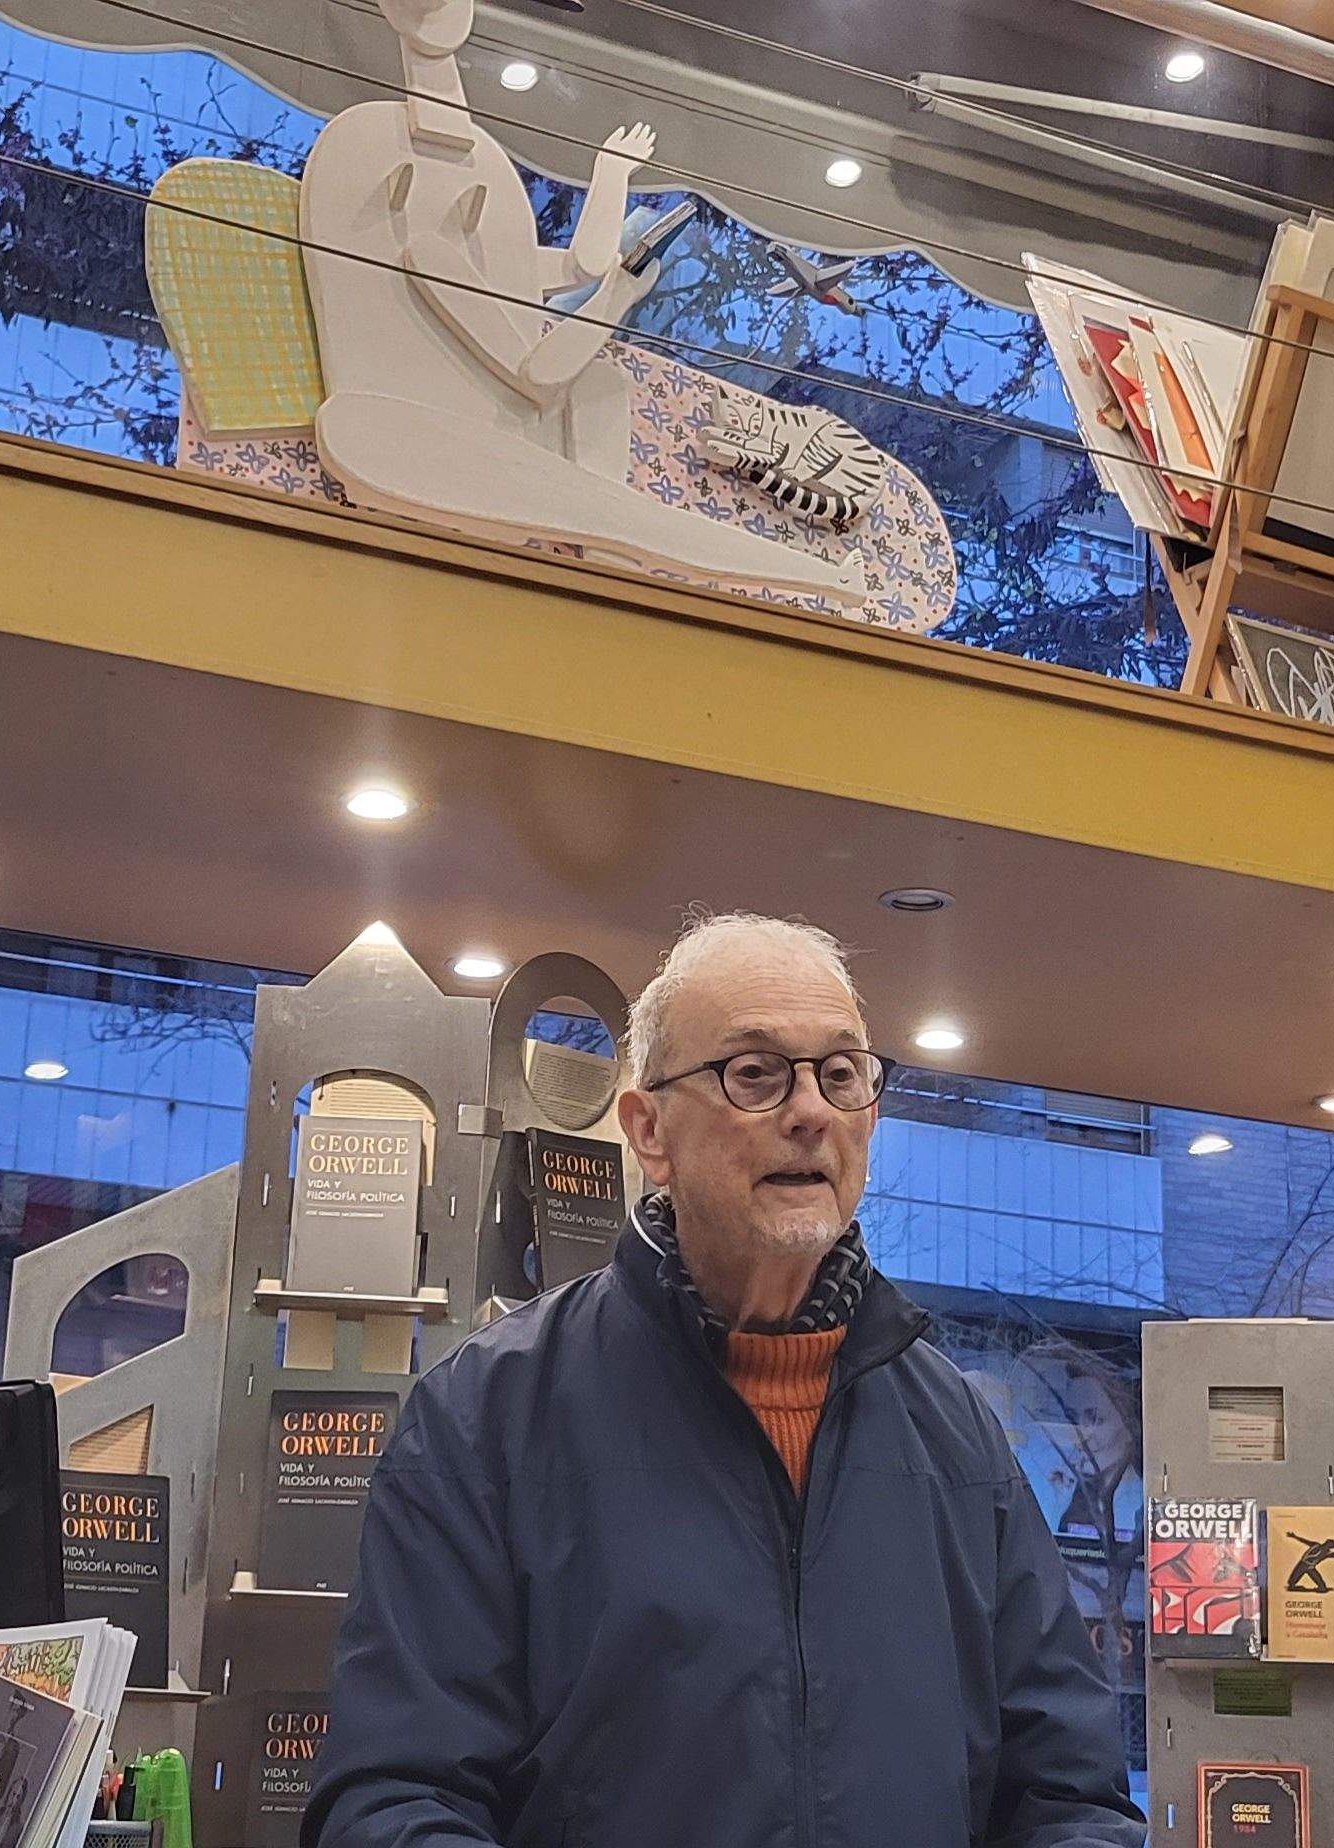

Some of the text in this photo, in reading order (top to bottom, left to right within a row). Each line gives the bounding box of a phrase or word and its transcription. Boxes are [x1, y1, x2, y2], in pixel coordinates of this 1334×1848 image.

[311, 1134, 409, 1155] GEORGE
[309, 1155, 408, 1176] ORWELL
[543, 1150, 616, 1180] GEORGE
[307, 1179, 341, 1189] VIDA Y
[545, 1172, 617, 1201] ORWELL
[306, 1191, 405, 1202] FILOSOFÍA POLÍTICA
[548, 1198, 562, 1208] VIDA
[283, 1412, 385, 1433] GEORGE
[281, 1435, 383, 1457] ORWELL
[280, 1463, 315, 1473] VIDA Y
[278, 1474, 371, 1488] FILOSOFÍA POLÍTIC
[62, 1491, 159, 1518] GEORGE
[1165, 1504, 1243, 1519] GEORGE
[62, 1517, 160, 1543] ORWELL
[1155, 1519, 1253, 1538] ORWELL
[62, 1546, 95, 1557] VIDA Y
[62, 1559, 158, 1575] FILOSOFÍA POLÍTICA
[1285, 1601, 1323, 1609] GEORGE
[1285, 1610, 1323, 1618] ORWELL
[268, 1713, 328, 1734] GEO
[266, 1738, 322, 1760] ORW
[263, 1768, 299, 1778] VIDA Y
[262, 1781, 311, 1792] FILOSOFÍ
[1232, 1803, 1271, 1814] GEORGE
[1232, 1813, 1272, 1824] ORWELL
